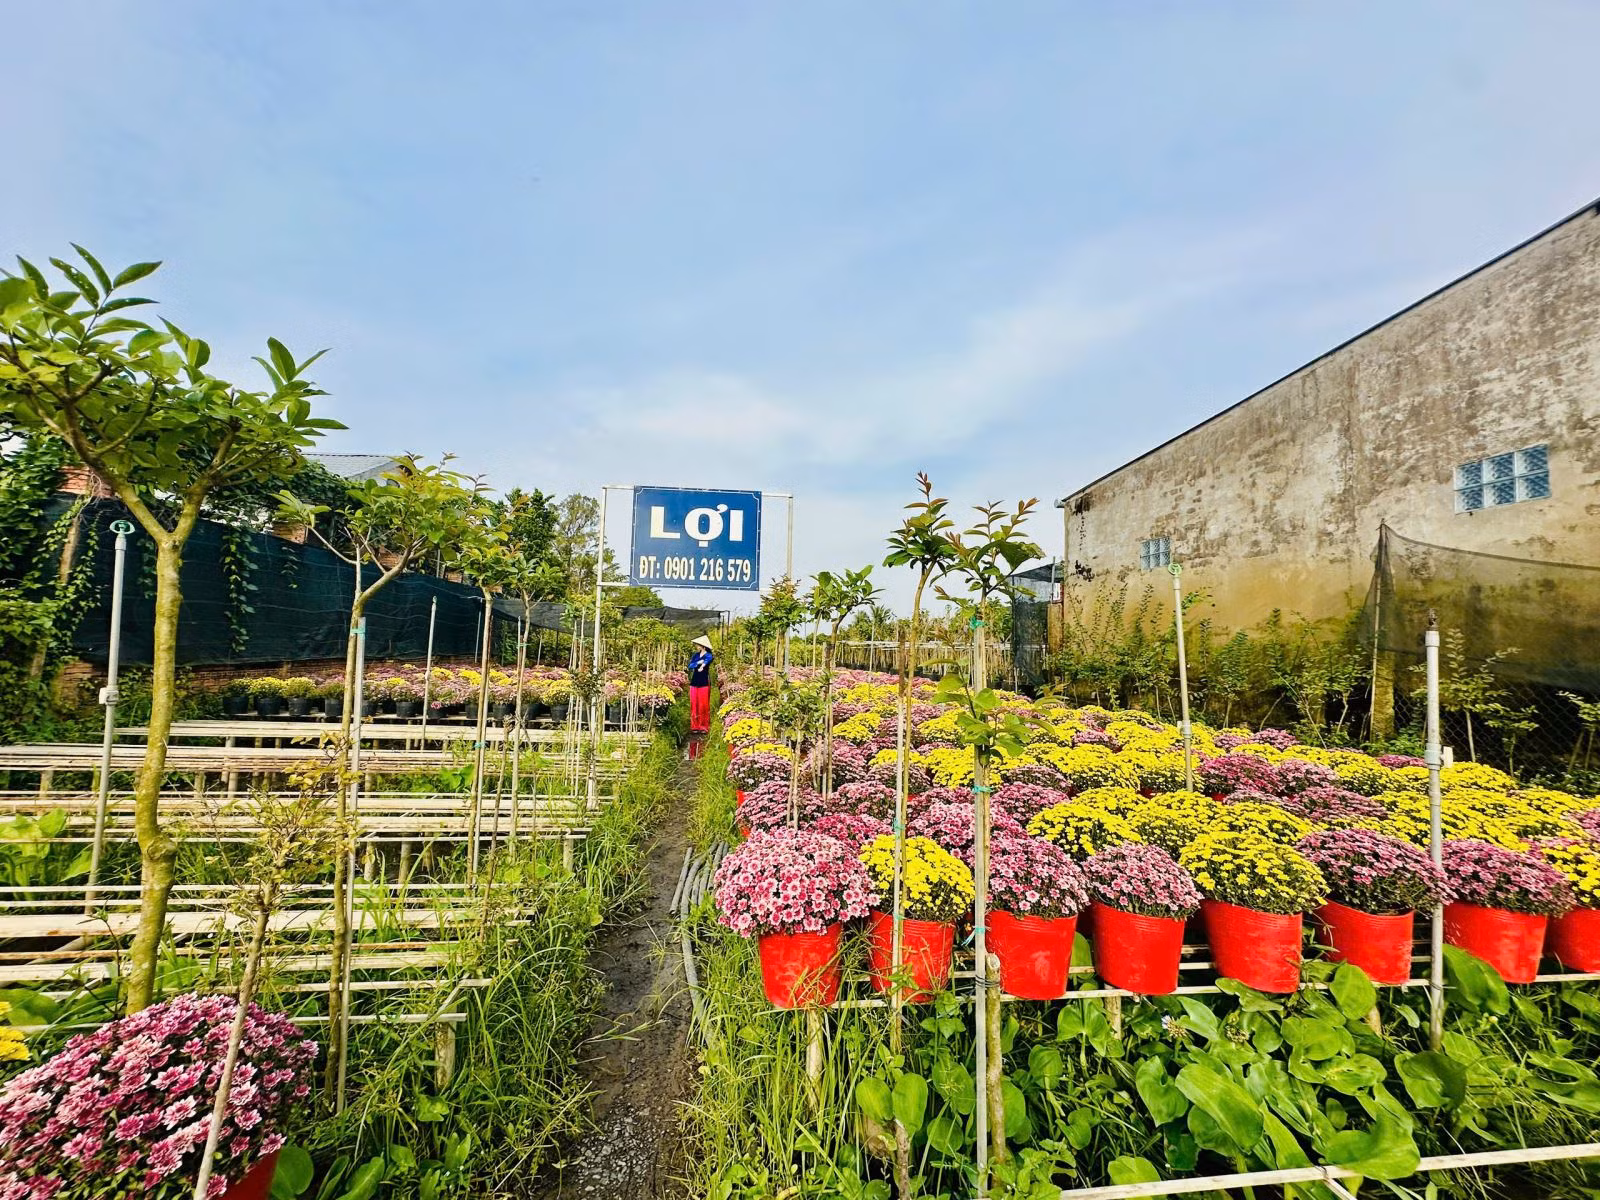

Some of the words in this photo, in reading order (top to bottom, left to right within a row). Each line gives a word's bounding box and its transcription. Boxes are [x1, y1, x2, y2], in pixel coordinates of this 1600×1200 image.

[650, 504, 744, 548] LỢI
[639, 555, 660, 579] ĐT:
[664, 556, 695, 580] 0901
[700, 558, 724, 581] 216
[727, 559, 751, 583] 579
